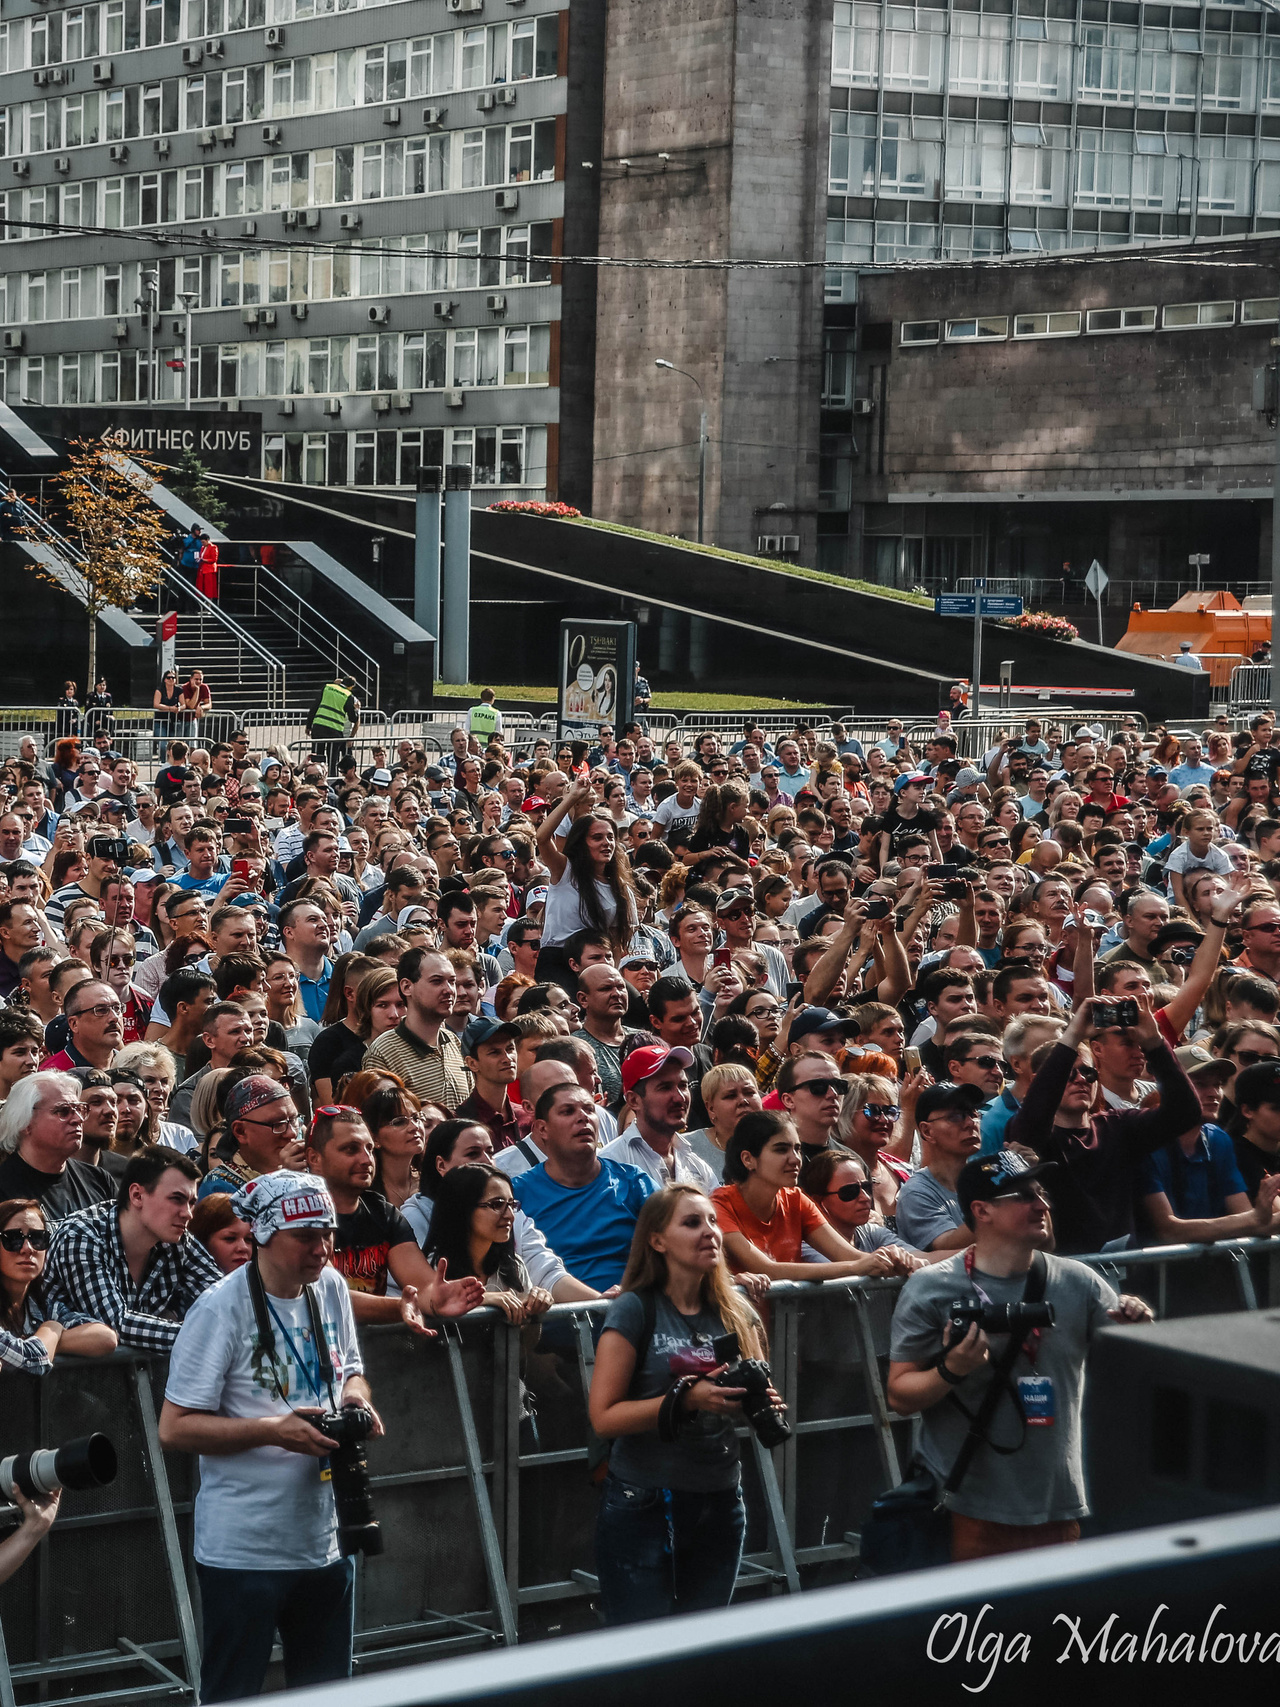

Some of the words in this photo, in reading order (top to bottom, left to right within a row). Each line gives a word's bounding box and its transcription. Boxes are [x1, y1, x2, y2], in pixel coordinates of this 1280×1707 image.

[114, 428, 194, 450] ФИТНЕС
[201, 430, 250, 450] КЛУБ
[473, 712, 495, 721] ОХРАНА
